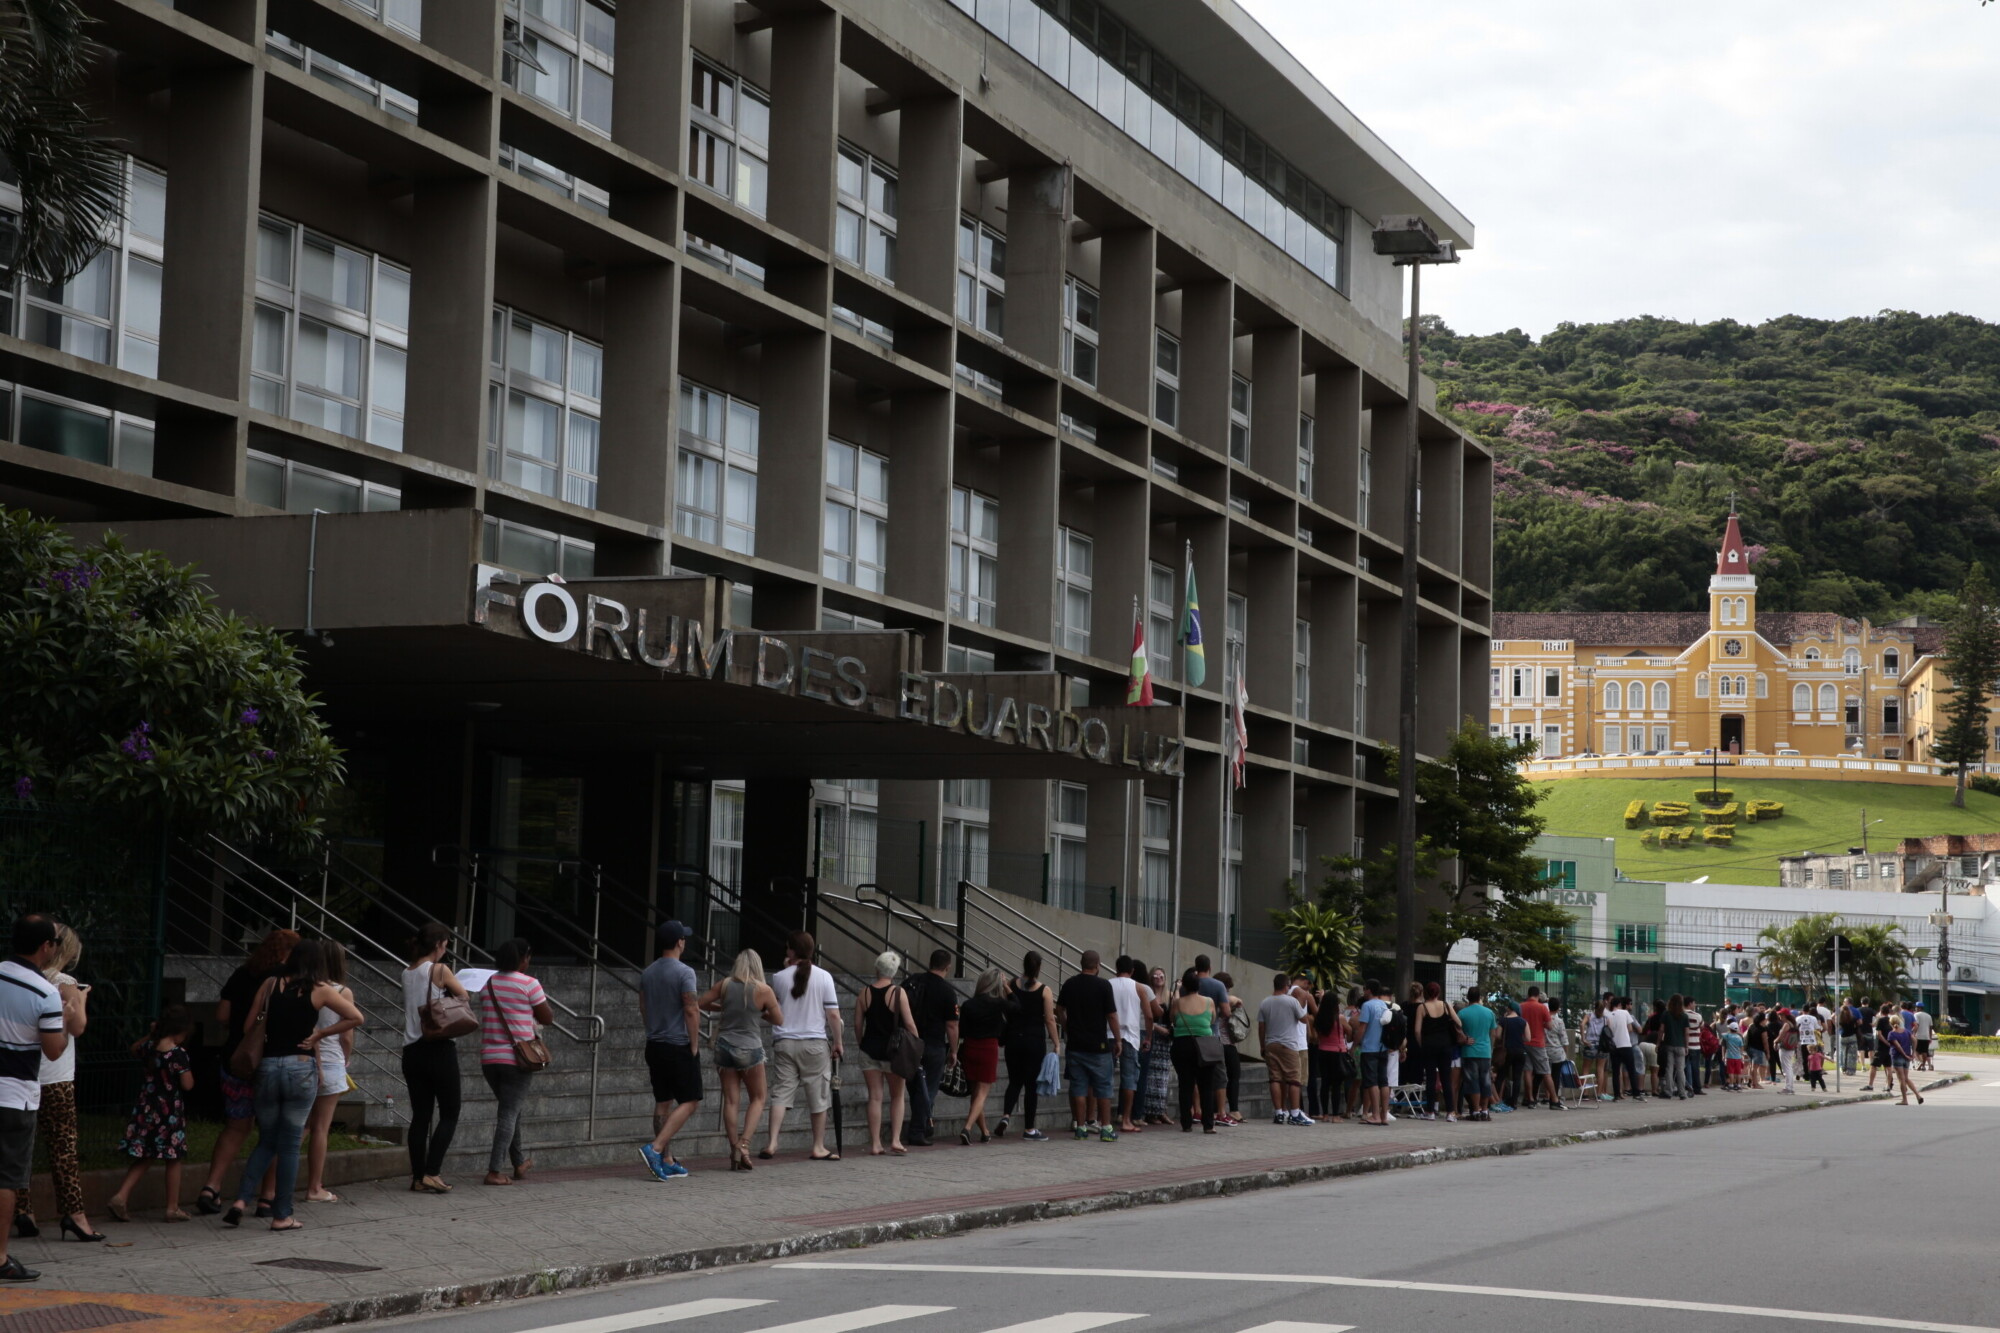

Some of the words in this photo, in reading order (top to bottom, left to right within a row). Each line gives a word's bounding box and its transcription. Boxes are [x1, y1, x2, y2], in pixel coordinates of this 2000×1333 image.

[474, 563, 734, 681] FÓRUM
[899, 671, 1110, 761] EDUARDO
[1122, 723, 1185, 778] LUZ
